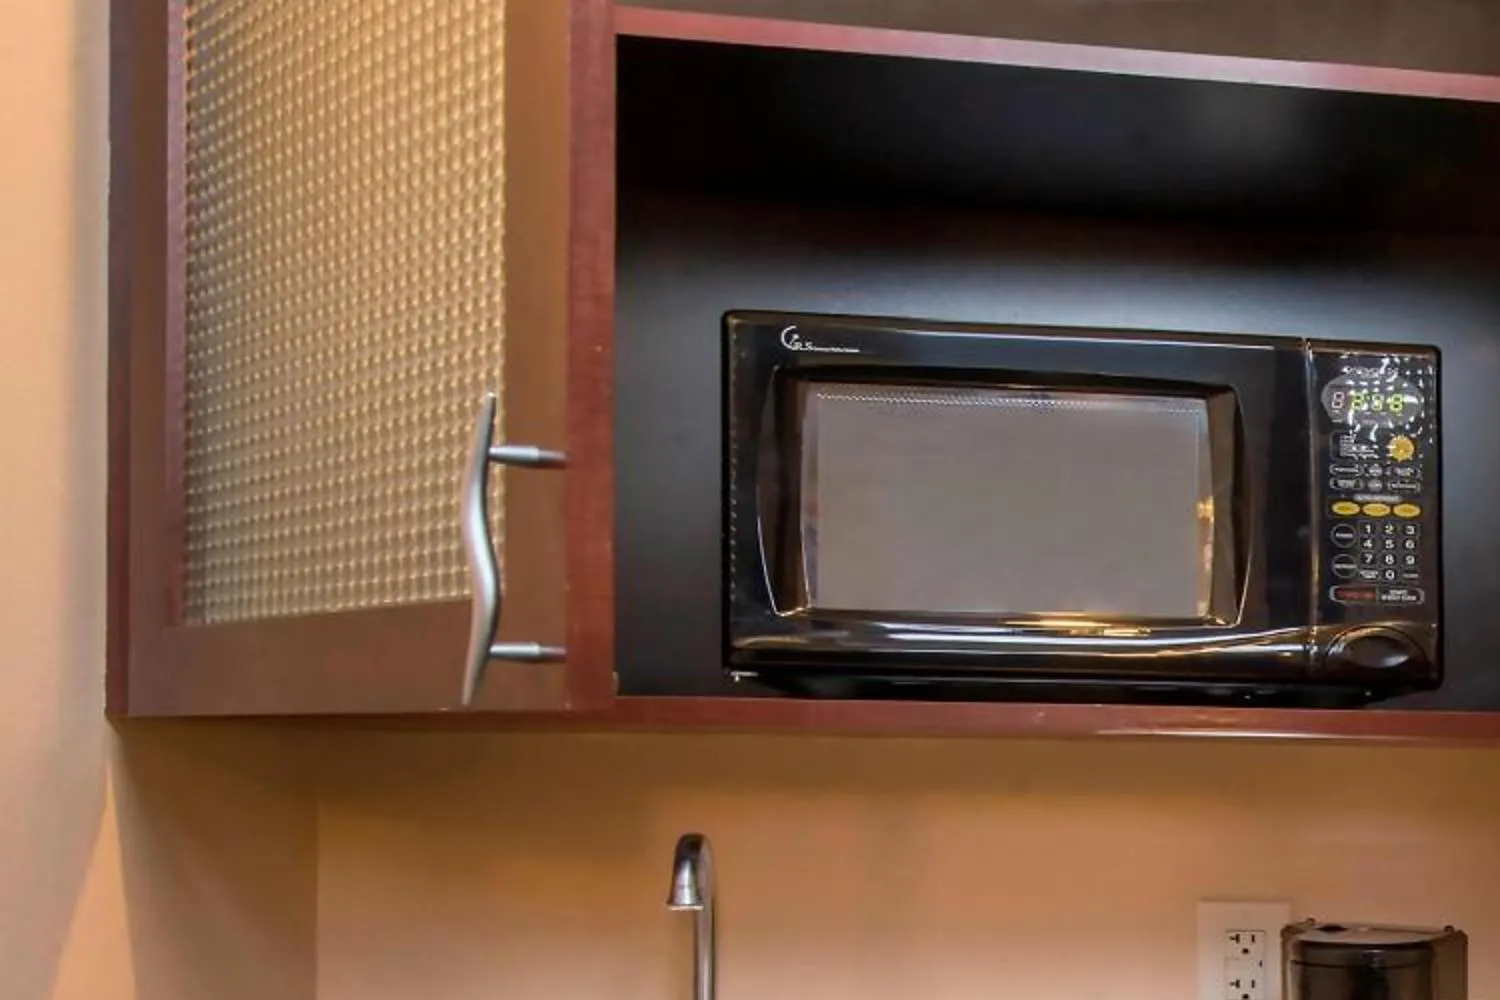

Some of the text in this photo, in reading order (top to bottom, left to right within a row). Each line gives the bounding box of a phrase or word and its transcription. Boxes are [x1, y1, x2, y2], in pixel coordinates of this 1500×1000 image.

[1366, 524, 1415, 535] 1 2 3
[1363, 540, 1415, 549] 4 5 6
[1364, 554, 1415, 565] 7 8 9
[1385, 569, 1395, 580] 0
